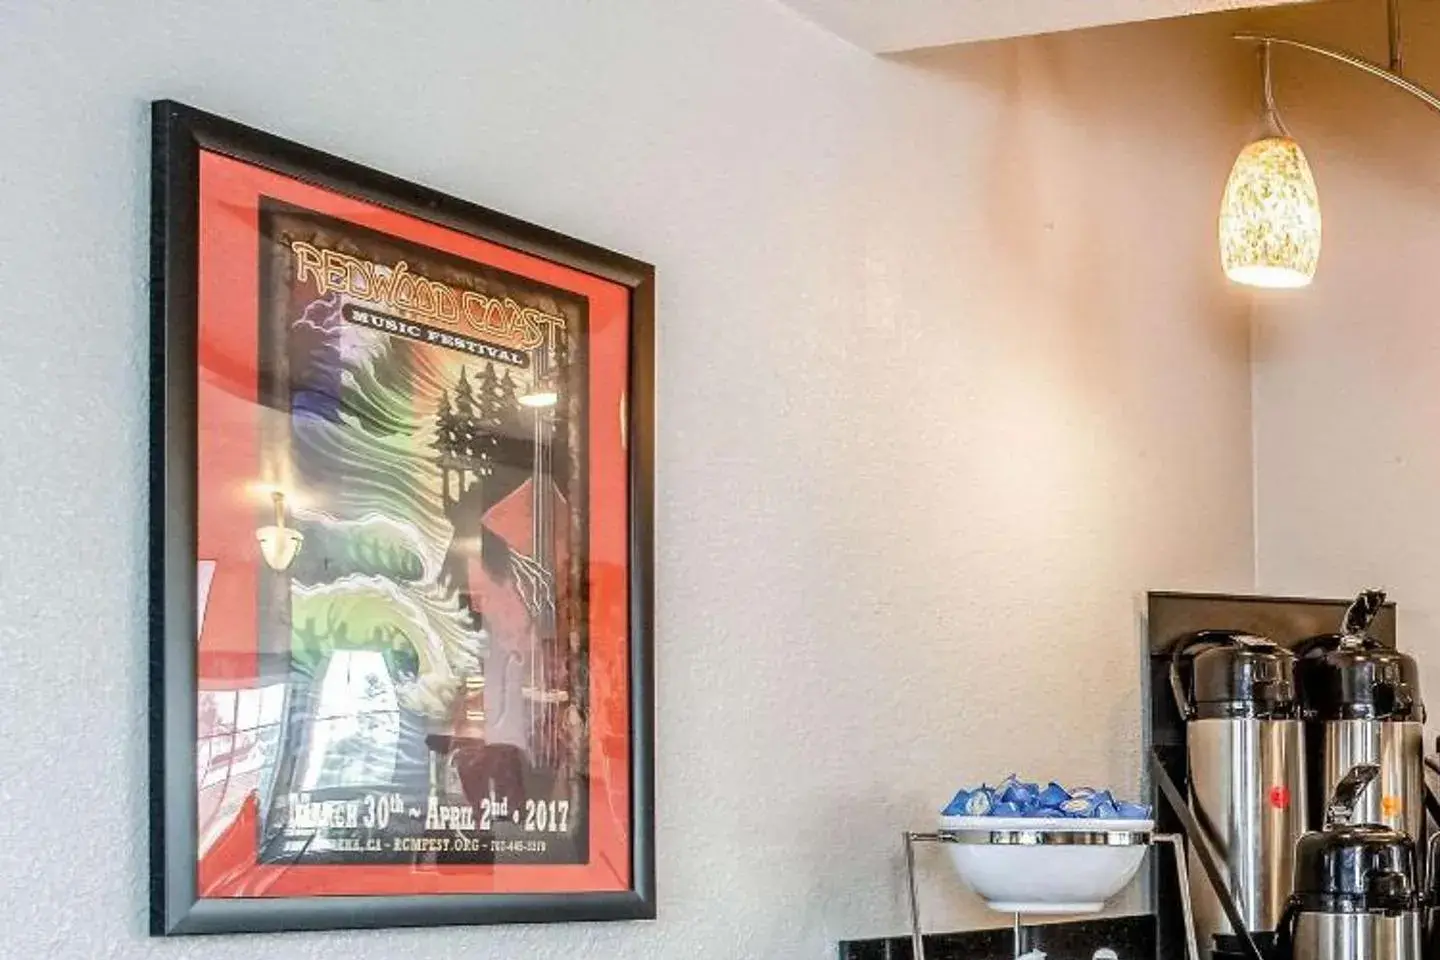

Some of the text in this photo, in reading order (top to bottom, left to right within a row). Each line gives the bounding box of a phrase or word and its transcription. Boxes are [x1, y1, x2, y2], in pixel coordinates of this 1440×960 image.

[292, 241, 566, 351] REDWOOD COAST
[352, 309, 523, 365] MUSIC FESTIVAL
[524, 798, 569, 832] 2017
